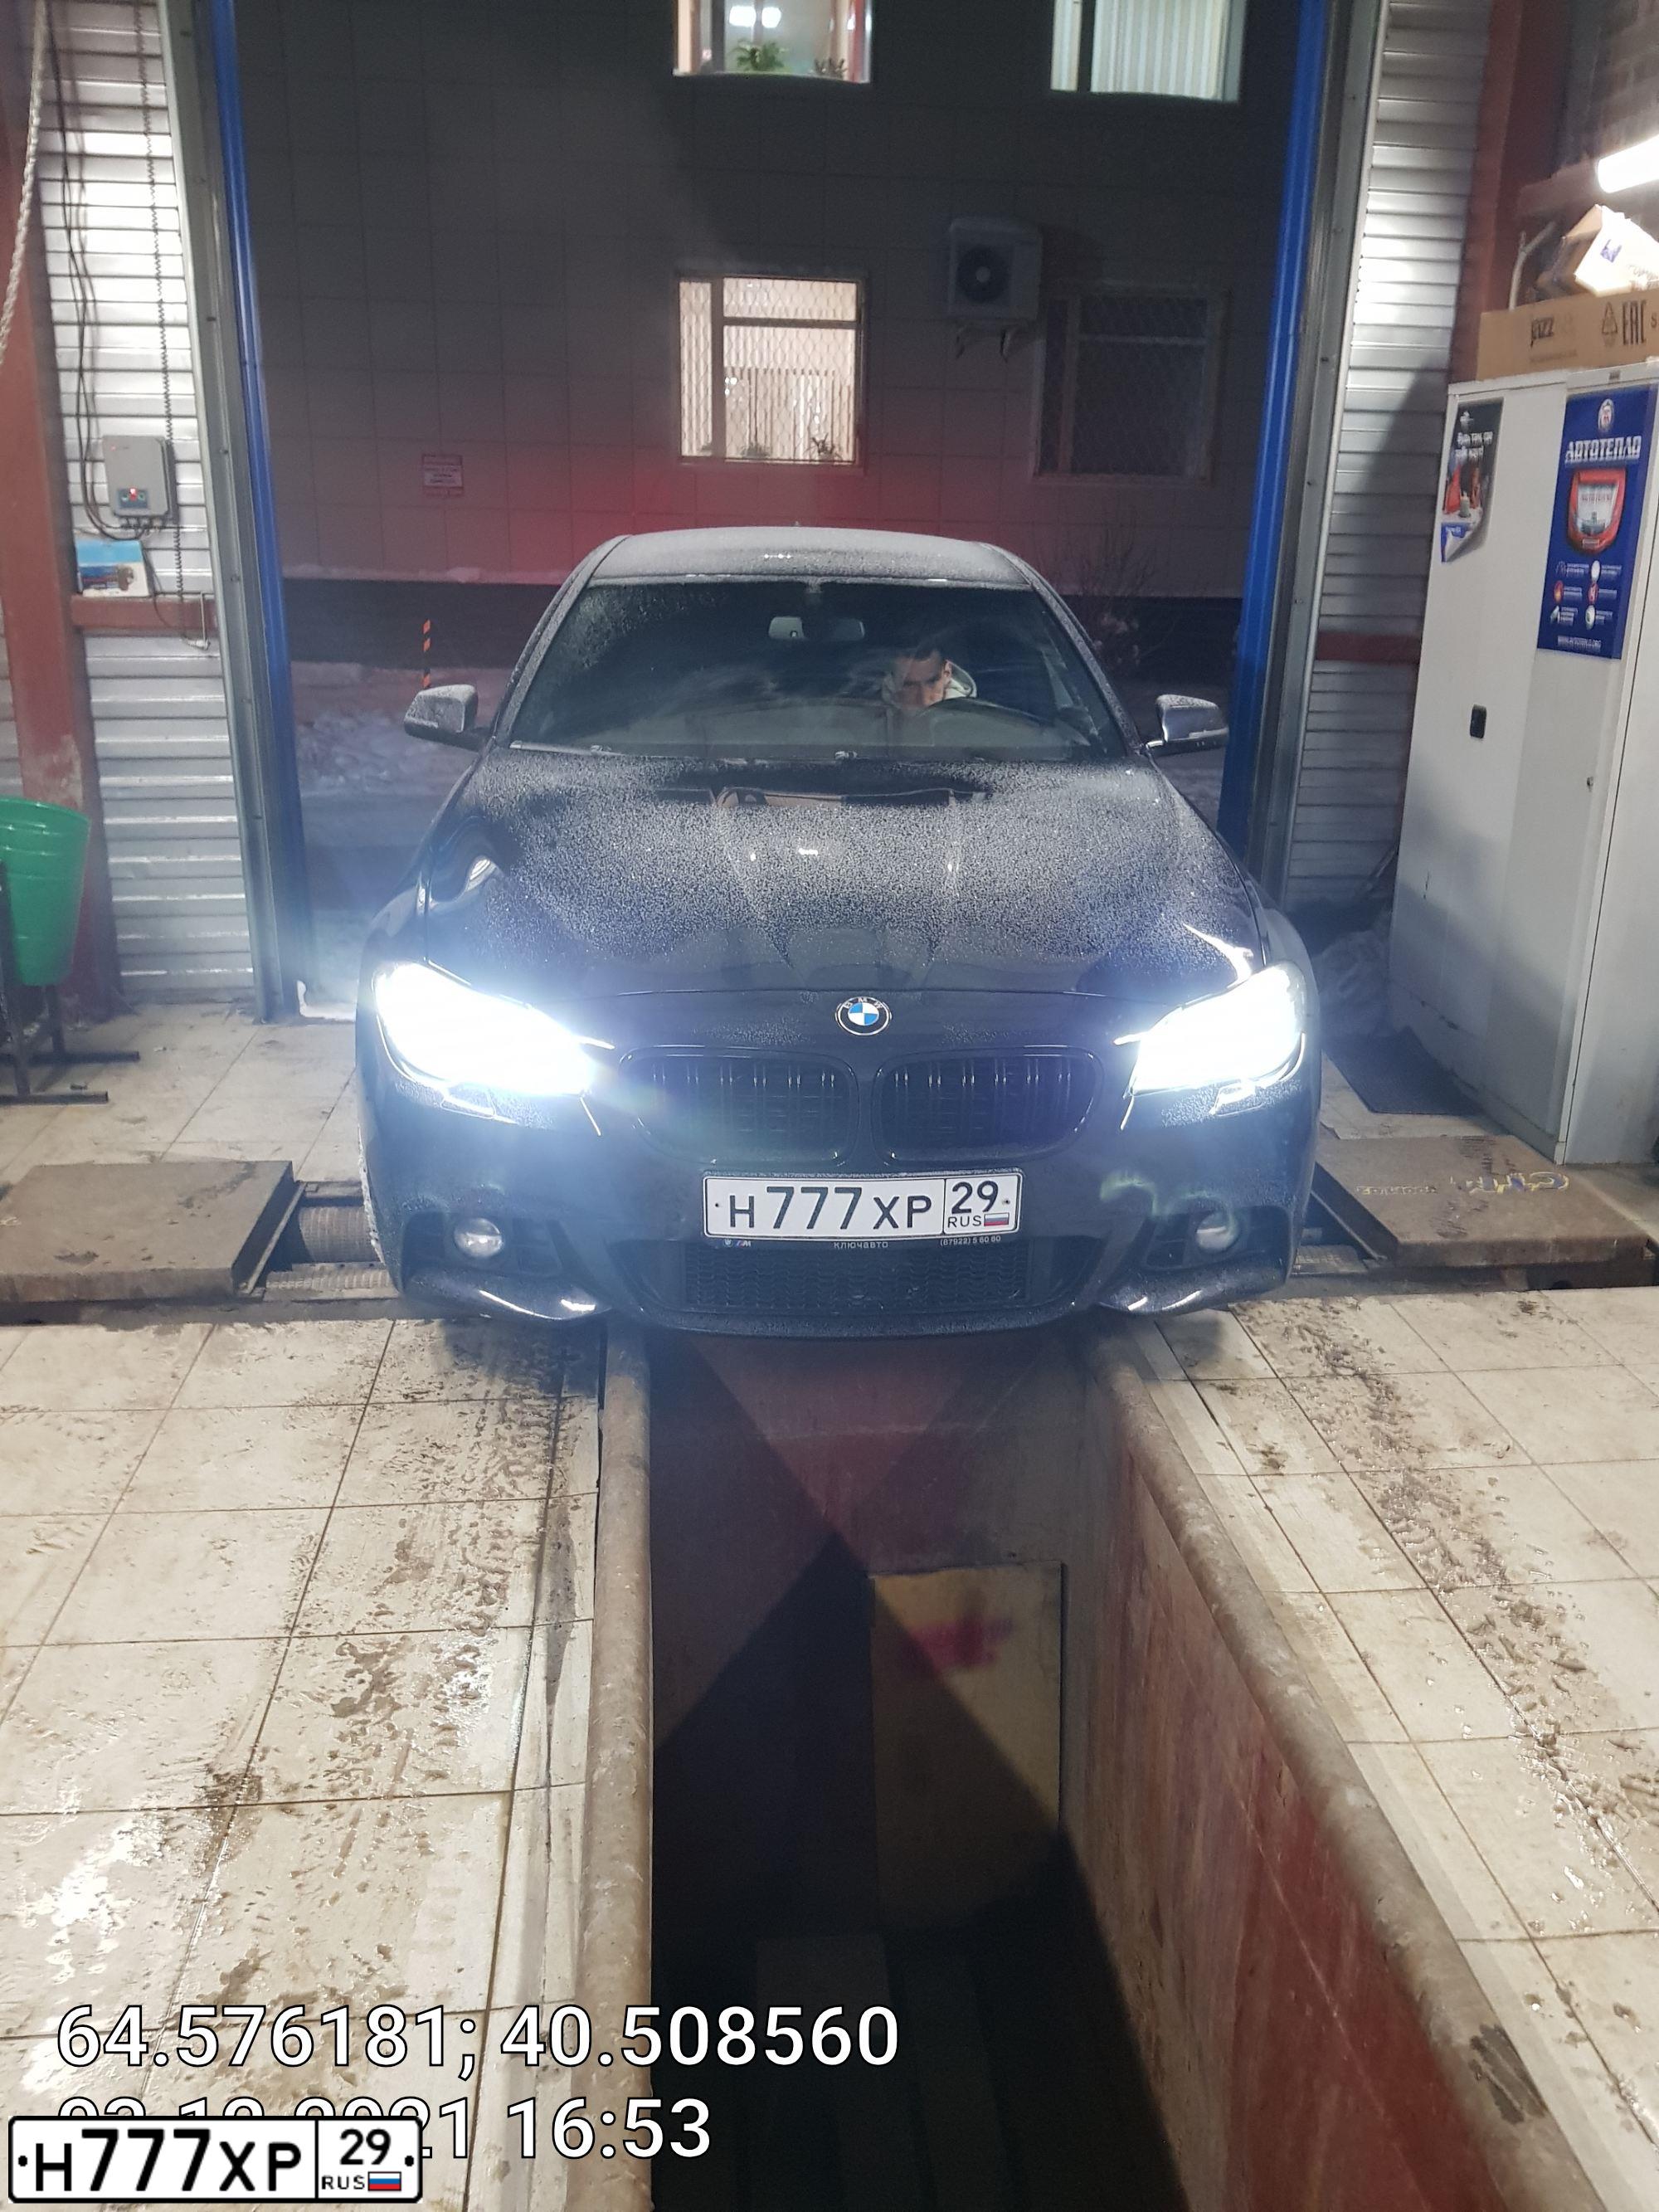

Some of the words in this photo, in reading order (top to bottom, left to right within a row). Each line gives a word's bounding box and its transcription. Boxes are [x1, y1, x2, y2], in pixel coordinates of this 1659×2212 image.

[1564, 436, 1642, 464] АВТОТЕПЛО
[729, 1186, 932, 1230] Н777ХР
[951, 1181, 999, 1214] 29
[947, 1215, 982, 1228] RUS
